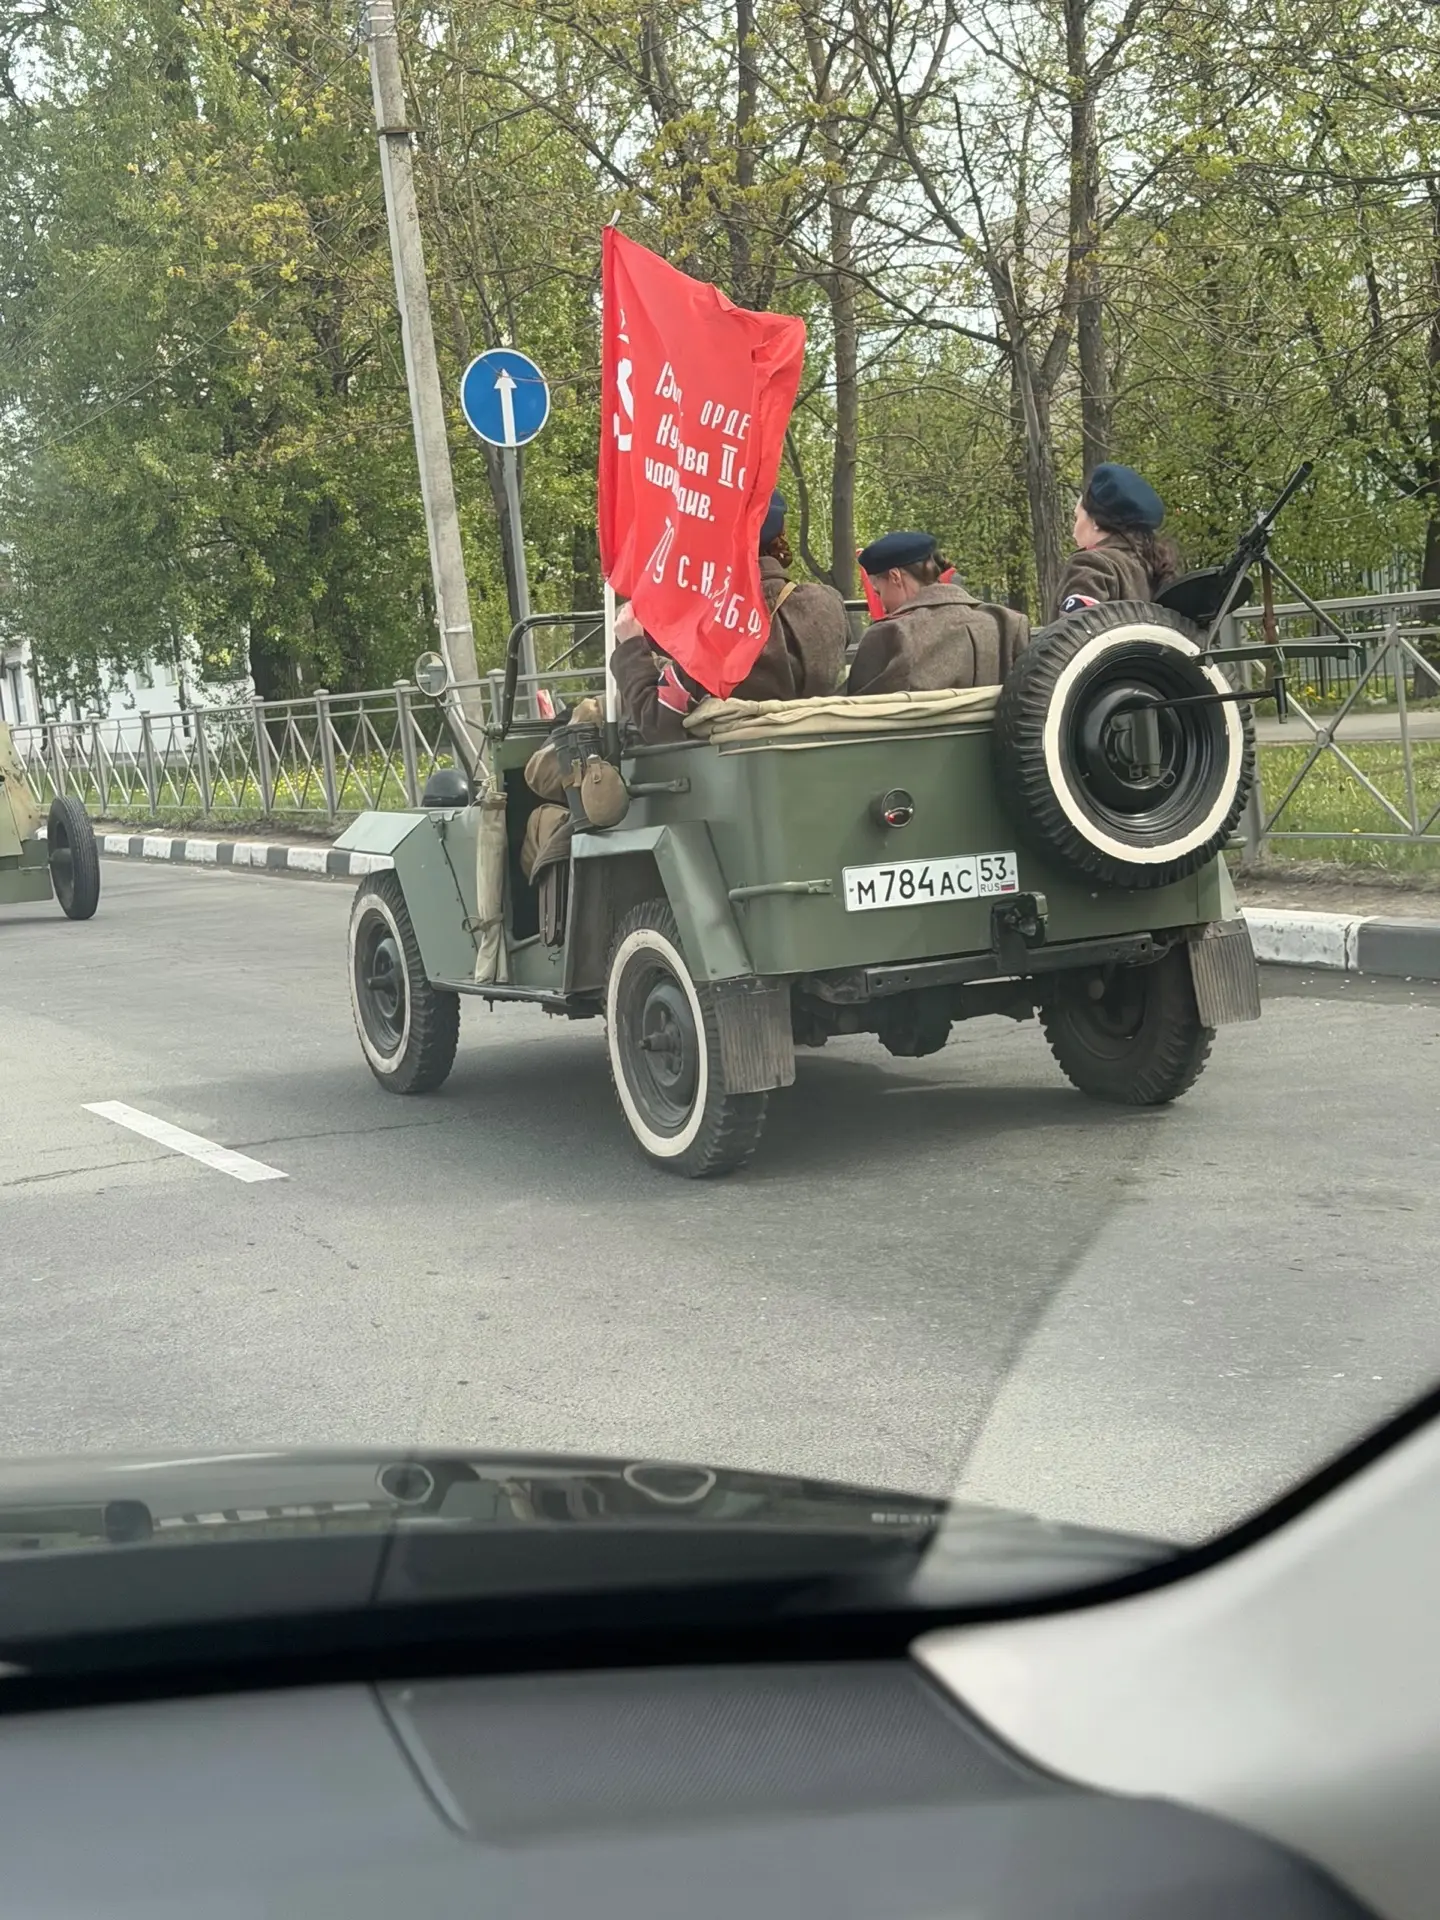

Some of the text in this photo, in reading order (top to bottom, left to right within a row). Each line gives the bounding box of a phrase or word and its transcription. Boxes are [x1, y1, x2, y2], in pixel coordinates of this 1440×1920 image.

[700, 400, 752, 440] ОРДЕ
[718, 443, 738, 488] II
[857, 866, 973, 905] М784АС
[980, 857, 1007, 882] 53
[980, 882, 1000, 893] RUS
